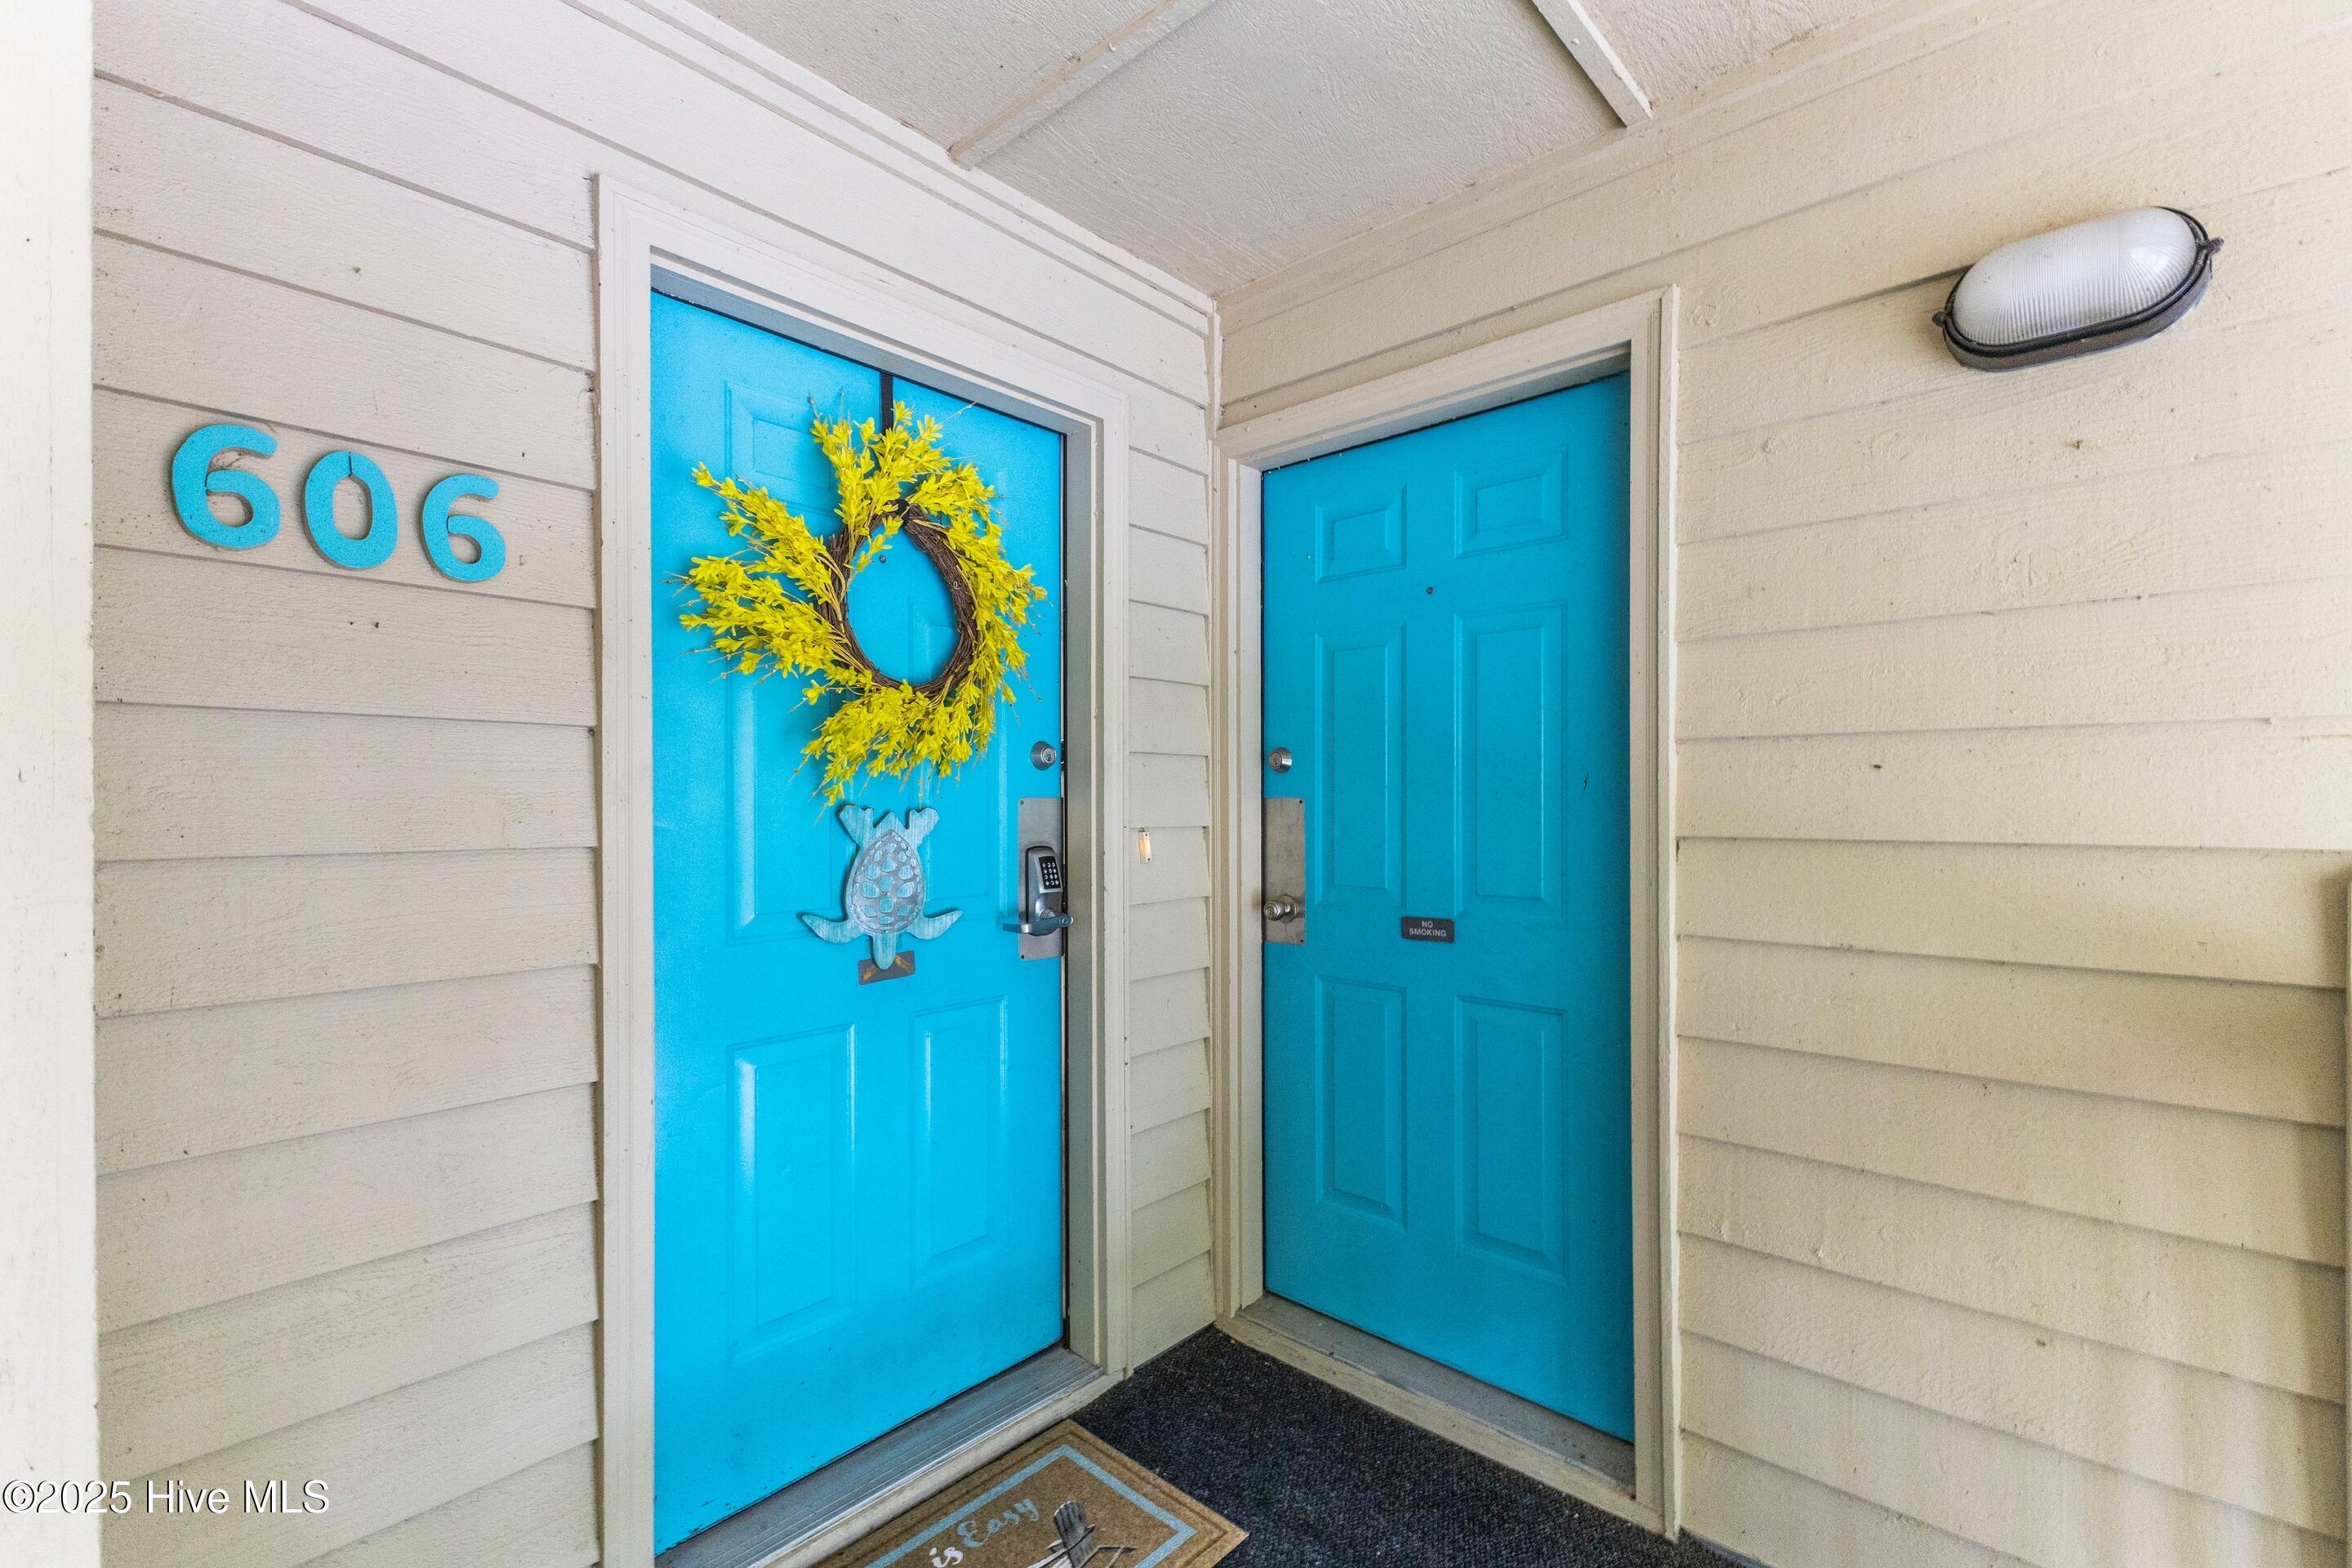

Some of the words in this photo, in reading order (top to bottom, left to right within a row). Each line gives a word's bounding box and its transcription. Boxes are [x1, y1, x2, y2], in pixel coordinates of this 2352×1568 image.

[171, 423, 506, 583] 606
[1409, 928, 1447, 937] SMOKING
[929, 1547, 964, 1568] is
[956, 1498, 1040, 1548] Easy
